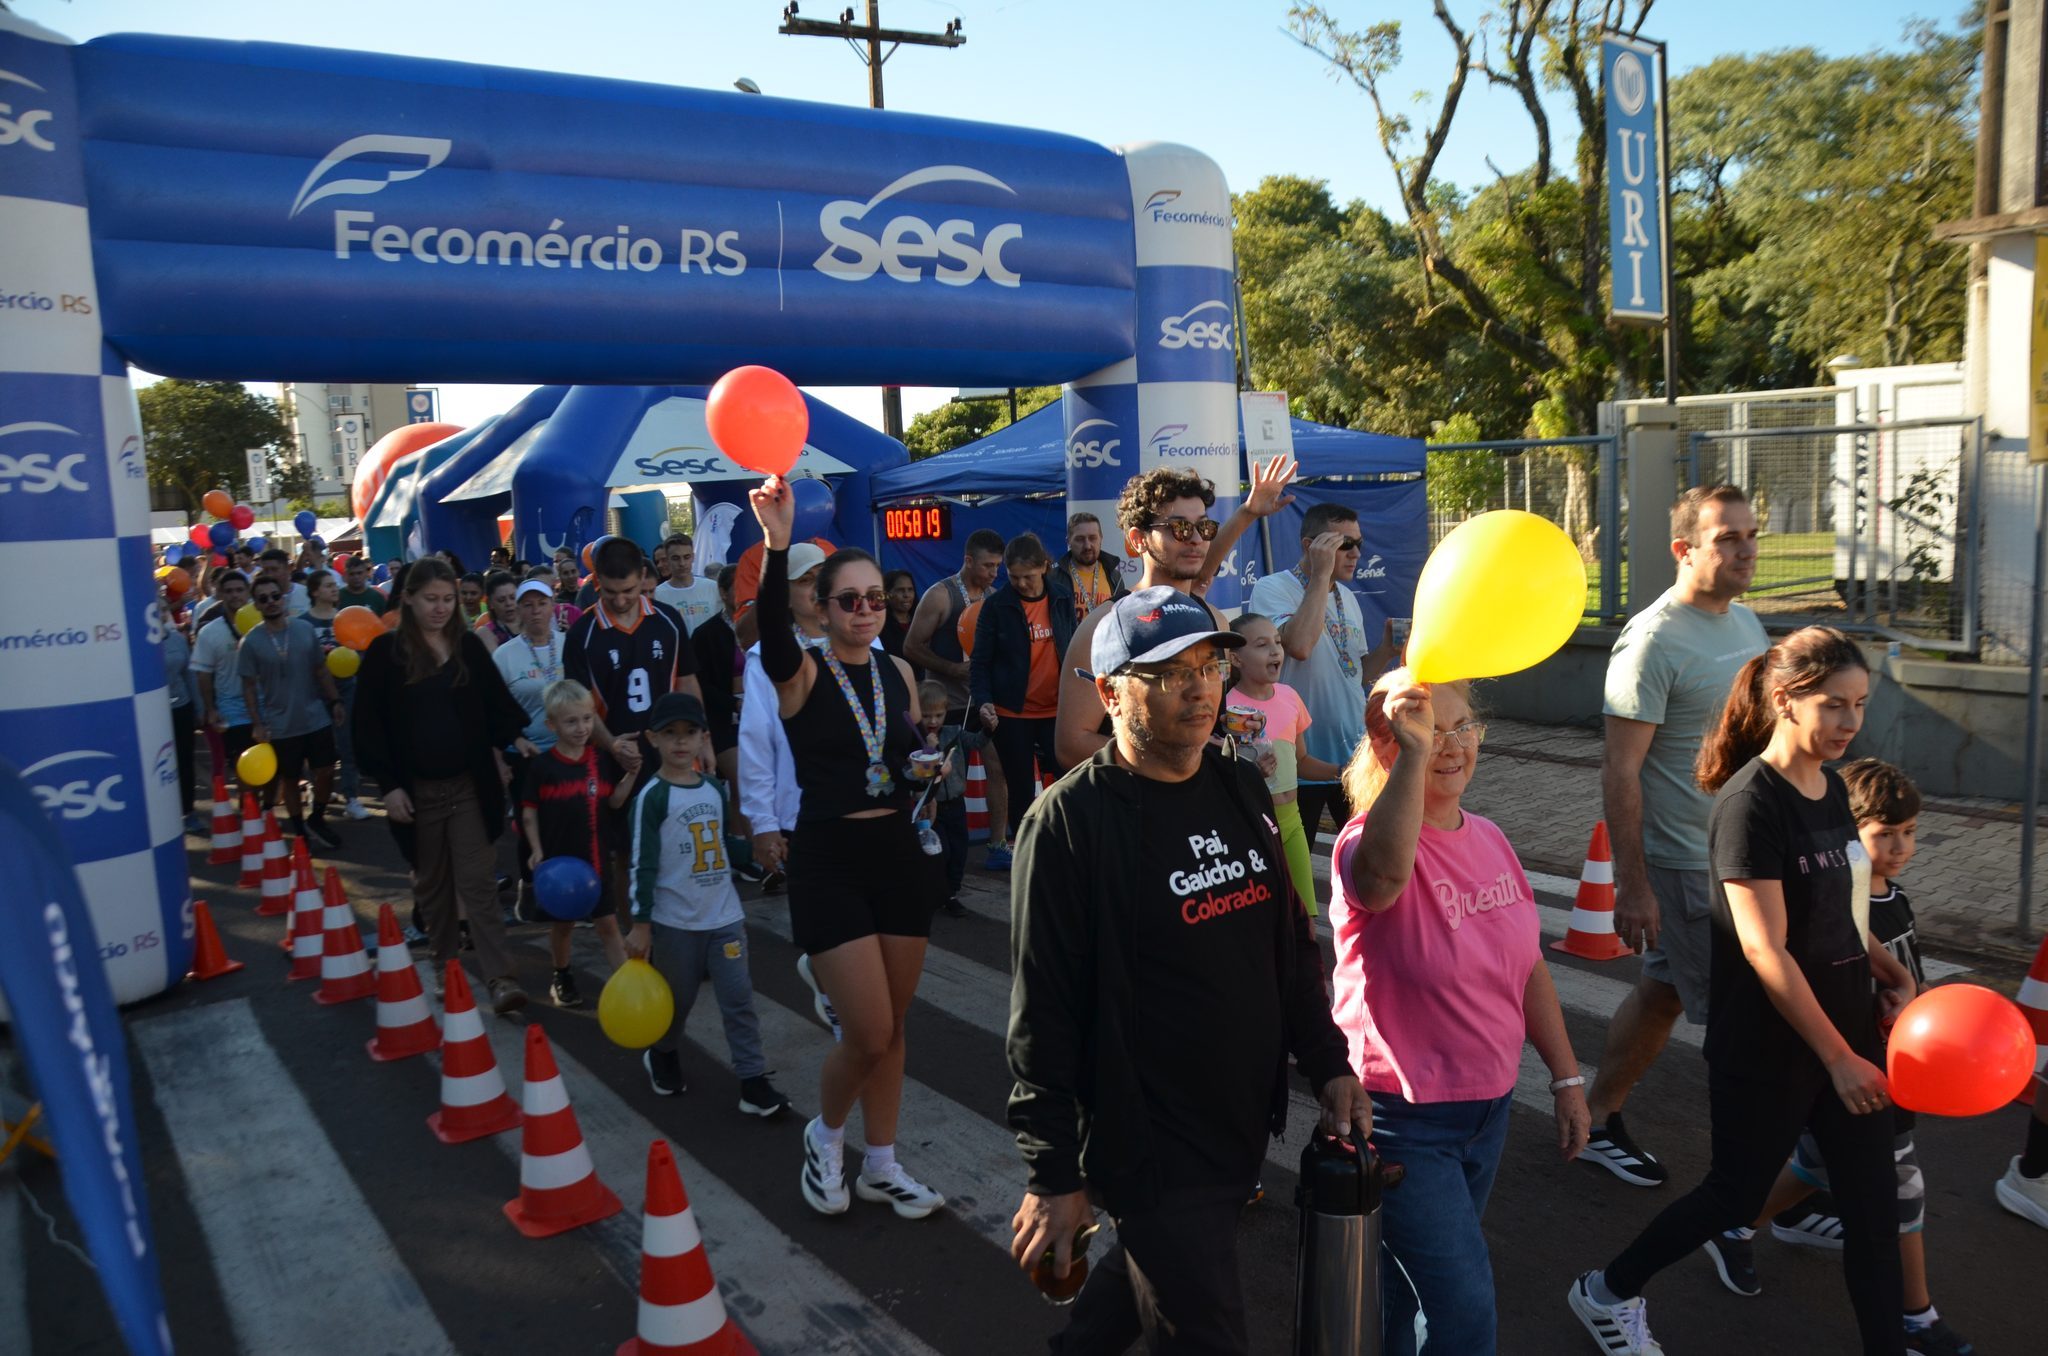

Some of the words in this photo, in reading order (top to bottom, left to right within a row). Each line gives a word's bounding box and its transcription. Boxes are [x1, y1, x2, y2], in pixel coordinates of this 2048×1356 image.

[1617, 127, 1650, 307] URI
[334, 210, 663, 272] Fecomércio
[680, 228, 748, 276] RS
[812, 199, 1023, 288] Sesc
[61, 294, 92, 315] RS
[633, 456, 728, 478] Sesc
[1158, 442, 1231, 457] Fecomércio
[95, 624, 122, 643] RS
[627, 667, 652, 713] 9
[688, 820, 726, 873] H
[1188, 829, 1229, 860] Pai,
[1169, 858, 1246, 896] Gaúcho
[1248, 848, 1268, 873] &
[1181, 879, 1272, 925] Colorado.
[1432, 871, 1524, 931] Breath
[133, 931, 160, 953] RS
